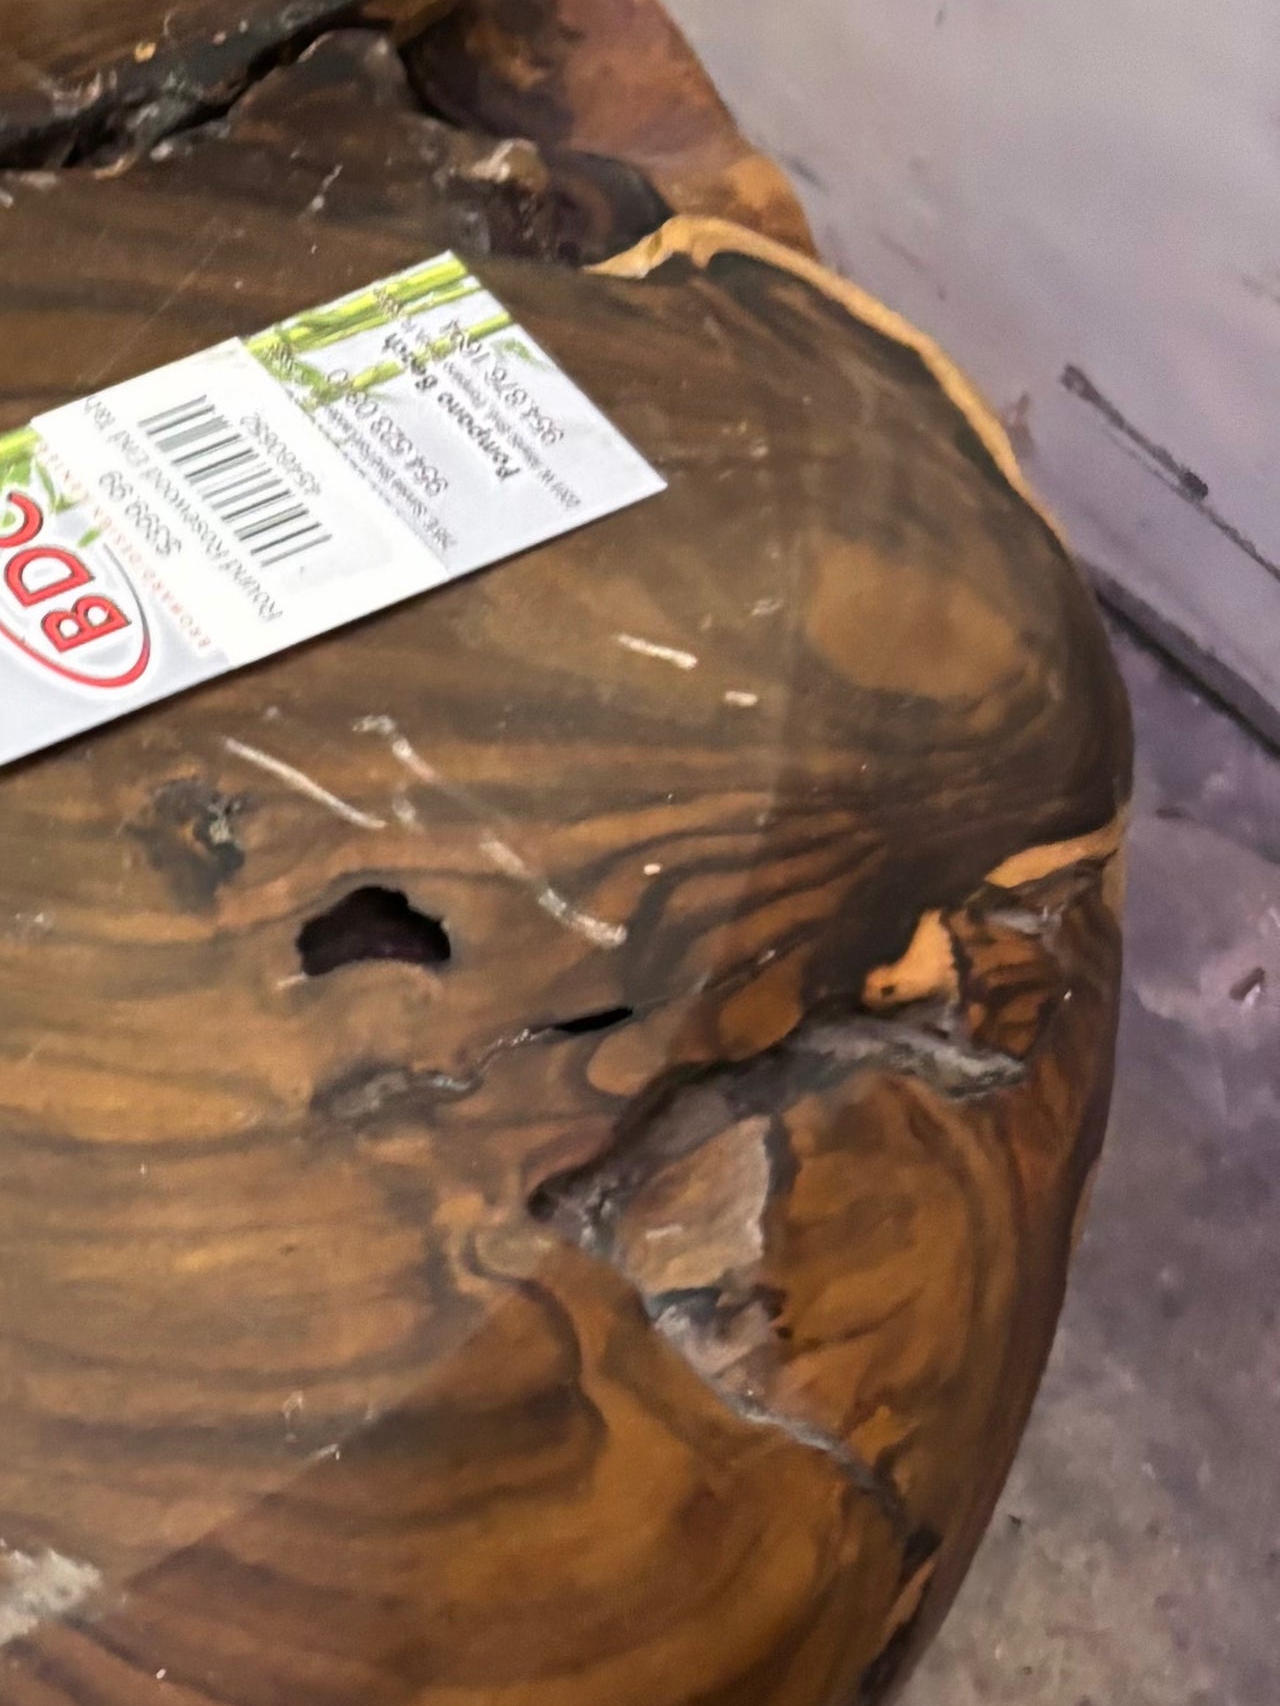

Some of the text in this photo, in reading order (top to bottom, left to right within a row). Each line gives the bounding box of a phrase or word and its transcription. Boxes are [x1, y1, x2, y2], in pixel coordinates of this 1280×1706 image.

[378, 332, 440, 392] Beach
[106, 429, 150, 468] End
[433, 390, 523, 481] Pompano
[97, 470, 184, 557] $399.99
[139, 466, 230, 560] Rosewood
[218, 558, 284, 621] Round
